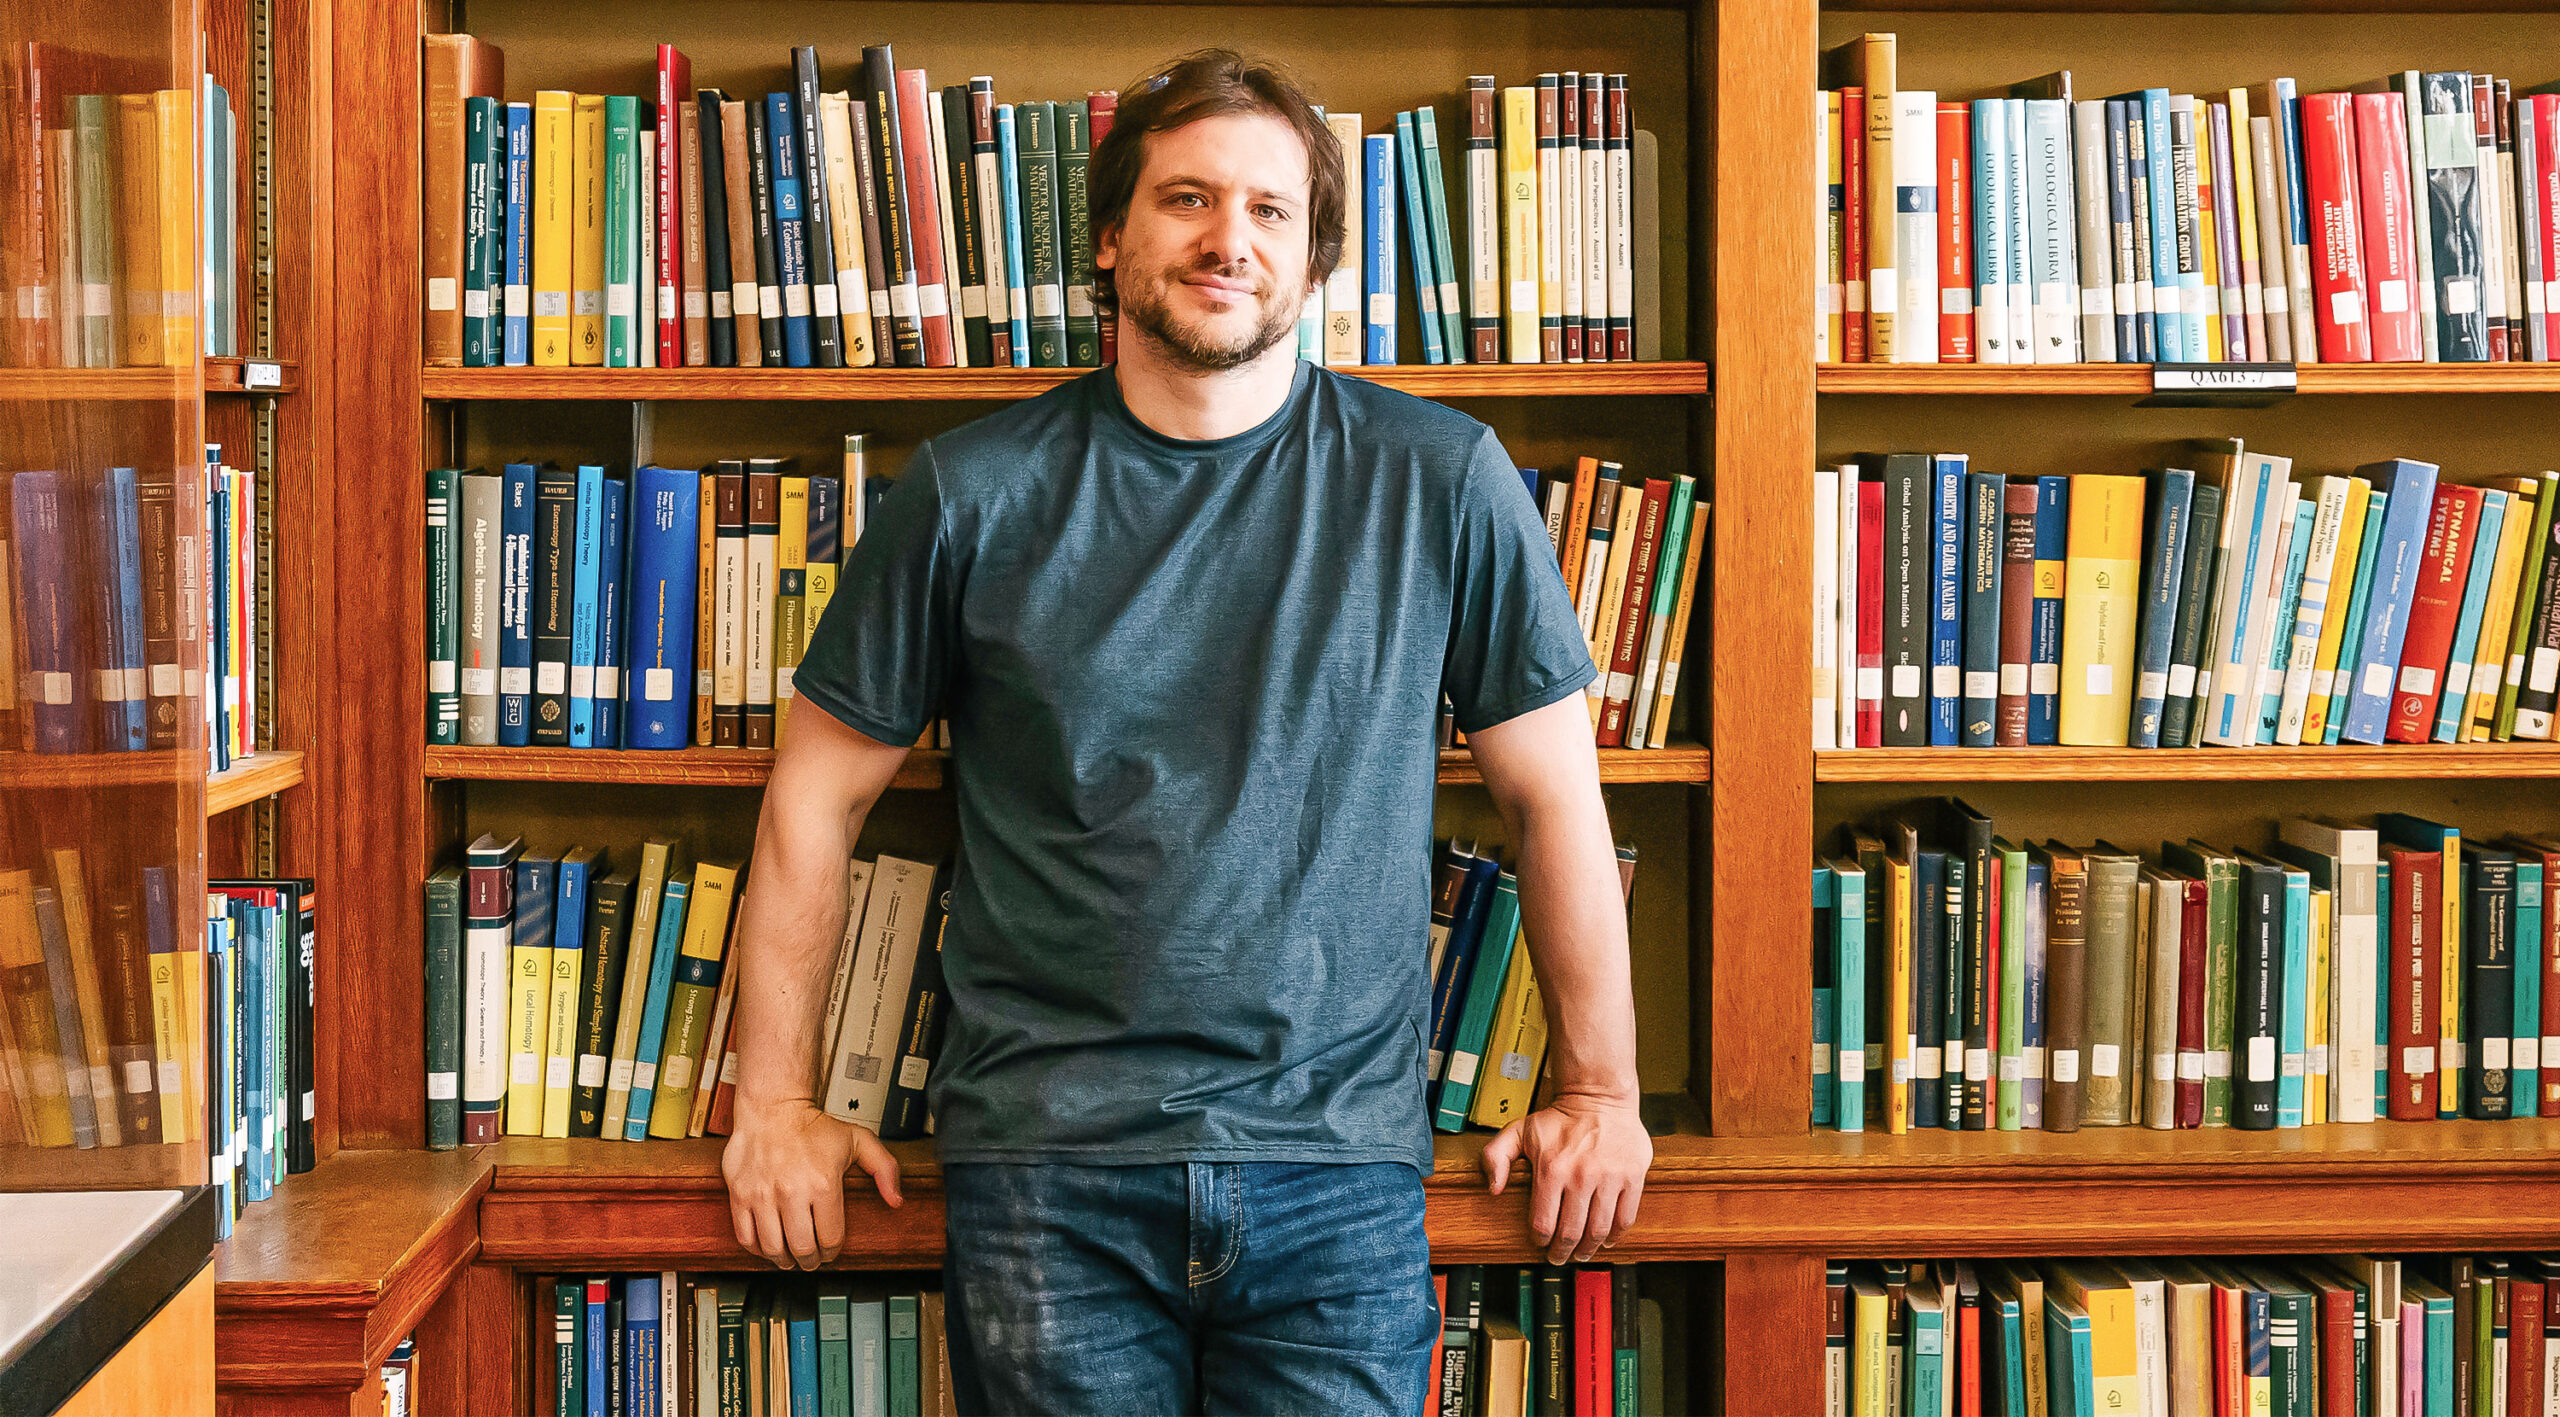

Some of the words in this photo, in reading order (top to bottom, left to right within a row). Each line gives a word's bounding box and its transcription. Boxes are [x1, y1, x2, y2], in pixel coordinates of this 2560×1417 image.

[2153, 100, 2162, 119] tom
[688, 128, 696, 164] RELATIVE
[1030, 112, 1040, 148] Hermann
[1068, 114, 1079, 150] Hermann
[2154, 123, 2164, 153] Dieck
[860, 140, 869, 177] FIBREWISE
[885, 158, 893, 174] FIBRE
[1617, 156, 1623, 165] An
[2186, 150, 2197, 166] THE
[470, 164, 478, 190] Sheaves
[477, 164, 486, 197] Homology
[886, 176, 895, 201] BUNDLES
[1038, 165, 1049, 207] VECTOR
[1077, 167, 1086, 209] VECTOR
[2044, 135, 2057, 233] TOPOLOGICAL
[2173, 149, 2188, 232] TRANSFORMATION
[2187, 168, 2198, 204] THEORY
[2383, 171, 2393, 214] COXETER
[864, 179, 874, 216] TOPOLOGY
[1030, 165, 1043, 246] MATHEMATICAL
[1068, 167, 1079, 247] MATHEMATICAL
[1592, 185, 1600, 228] Perspectives
[1985, 153, 1996, 245] TOPOLOGICAL
[2011, 154, 2022, 246] TOPOLOGICAL
[2155, 158, 2168, 237] Transformation
[2188, 207, 2199, 219] OF
[469, 209, 478, 234] Duality
[477, 210, 485, 237] Analytic
[690, 214, 697, 224] OF
[793, 222, 802, 238] Basic
[890, 210, 900, 249] DIFFERENTIAL
[1041, 211, 1051, 258] BUNDLES
[1829, 215, 1837, 248] Algebraic
[690, 226, 698, 263] SHEAVES
[783, 222, 793, 272] K-Cohomology
[794, 241, 803, 264] Bundle
[2178, 234, 2191, 271] GROUPS
[2324, 200, 2337, 280] ARRANGEMENTS
[2334, 207, 2346, 271] HYPERPLANE
[519, 258, 525, 266] of
[894, 251, 903, 282] GEOMETRY
[1033, 249, 1044, 284] PHYSIC
[1043, 262, 1051, 271] IN
[1071, 250, 1082, 284] PHYSIC
[1829, 251, 1837, 283] Cobordis
[1987, 249, 1998, 284] LIBRA
[2013, 249, 2023, 284] LIBRA
[2047, 238, 2059, 283] LIBRAR
[2158, 240, 2170, 275] Groups
[2346, 258, 2355, 278] FOR
[796, 266, 804, 285] Theor
[514, 482, 524, 507] Baues
[1902, 478, 1911, 505] Global
[1943, 474, 1956, 520] GEOMETRY
[1979, 484, 1987, 523] MODERN
[1987, 489, 1995, 526] GLOBAL
[2325, 492, 2333, 503] on
[2331, 495, 2343, 520] Global
[550, 504, 561, 547] Homotopy
[1575, 502, 1584, 525] Model
[1642, 499, 1659, 539] ADVANCED
[1900, 508, 1910, 544] Analysis
[2319, 505, 2332, 535] Foliated
[2429, 497, 2449, 557] SYSTEMS
[475, 518, 487, 574] Algebraic
[1548, 513, 1560, 550] BANAC
[1568, 527, 1581, 567] Categories
[1943, 523, 1956, 541] AND
[2325, 523, 2338, 555] Analysis
[2440, 499, 2465, 584] DYNAMICAL
[505, 534, 516, 585] 4-Dimensional
[518, 534, 529, 585] Combinatorial
[550, 549, 559, 570] Type
[1637, 542, 1652, 572] STUDIES
[1902, 546, 1909, 557] on
[1943, 544, 1956, 577] GLOBAL
[1977, 527, 1986, 592] MATHEMATICS
[1986, 530, 1994, 575] ANALYSIS
[2314, 537, 2326, 562] Spaces
[551, 572, 559, 587] and
[1567, 570, 1575, 585] and
[1635, 575, 1648, 583] IN
[1900, 559, 1909, 582] Open
[1986, 578, 1993, 588] IN
[472, 579, 486, 639] homotopy
[503, 588, 515, 627] Complexes
[515, 588, 528, 622] Homotopy
[549, 589, 559, 631] Homology
[1631, 586, 1646, 606] PURE
[1901, 584, 1910, 627] Manifolds
[1942, 580, 1955, 620] ANALYSIS
[517, 624, 527, 639] and
[786, 600, 795, 641] Fibrewise
[808, 606, 818, 631] Surgery
[1620, 608, 1640, 661] MATHEMATICS
[704, 881, 721, 891] SMM
[2412, 872, 2422, 912] ADVANCED
[599, 926, 610, 955] Abstract
[880, 931, 888, 943] and
[2412, 914, 2422, 945] STUDIES
[300, 934, 309, 968] 90
[873, 945, 885, 981] Applications
[883, 933, 895, 969] Deformation
[2412, 947, 2422, 956] IN
[2412, 958, 2421, 978] PURE
[594, 957, 607, 993] Homotopy
[877, 971, 890, 991] Theory
[526, 990, 535, 1008] Local
[595, 995, 603, 1008] and
[685, 989, 697, 1014] Strong
[870, 1002, 882, 1027] Algebras
[2412, 981, 2421, 1034] MATHEMATICS
[525, 1011, 534, 1048] Homotopy
[591, 1010, 602, 1032] Simple
[681, 1016, 693, 1038] Shape
[680, 1040, 688, 1054] and
[1549, 1332, 1559, 1359] Special
[611, 1366, 619, 1390] QUANTUM
[722, 1367, 731, 1404] Homotopy
[731, 1367, 741, 1398] Complex
[1443, 1350, 1456, 1406] Complex
[1453, 1351, 1466, 1393] Higher
[1549, 1360, 1558, 1400] Holonomy
